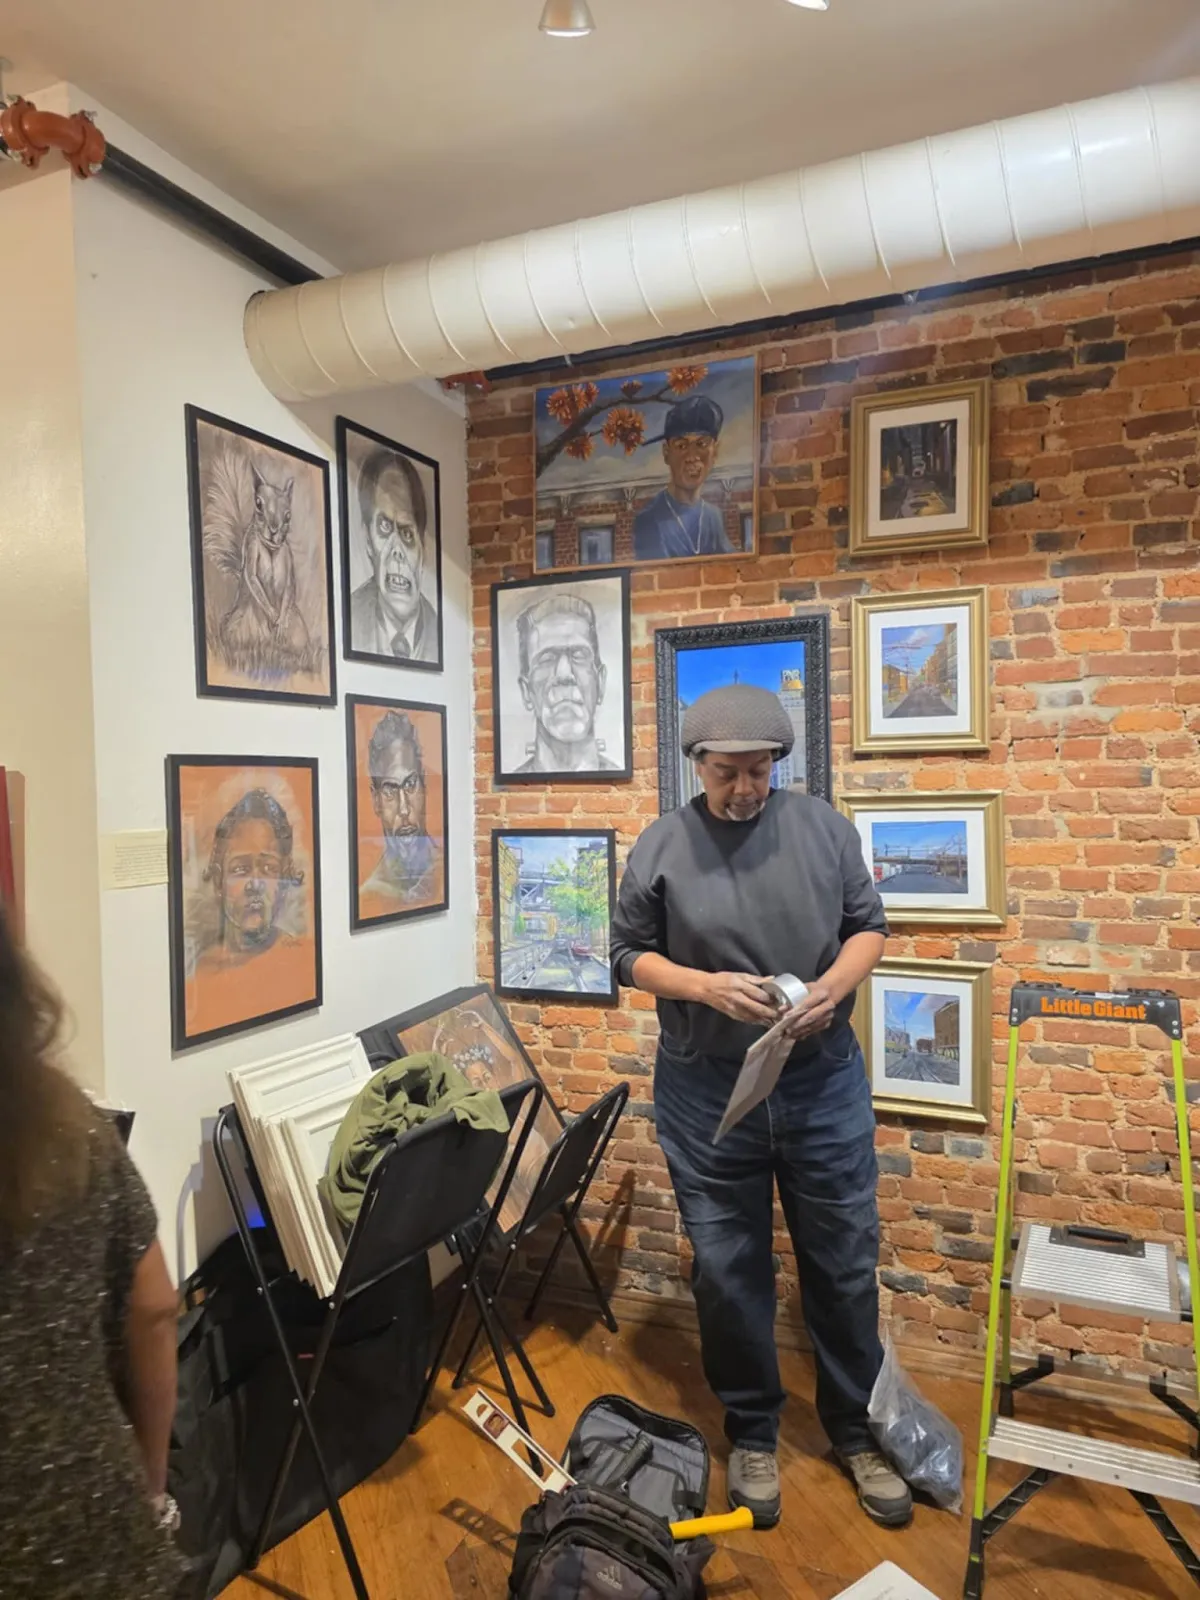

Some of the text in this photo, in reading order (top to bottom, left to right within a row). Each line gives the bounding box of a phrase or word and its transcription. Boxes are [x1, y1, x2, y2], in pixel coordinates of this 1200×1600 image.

[1040, 996, 1146, 1020] Little Giant
[596, 1571, 623, 1591] adidas
